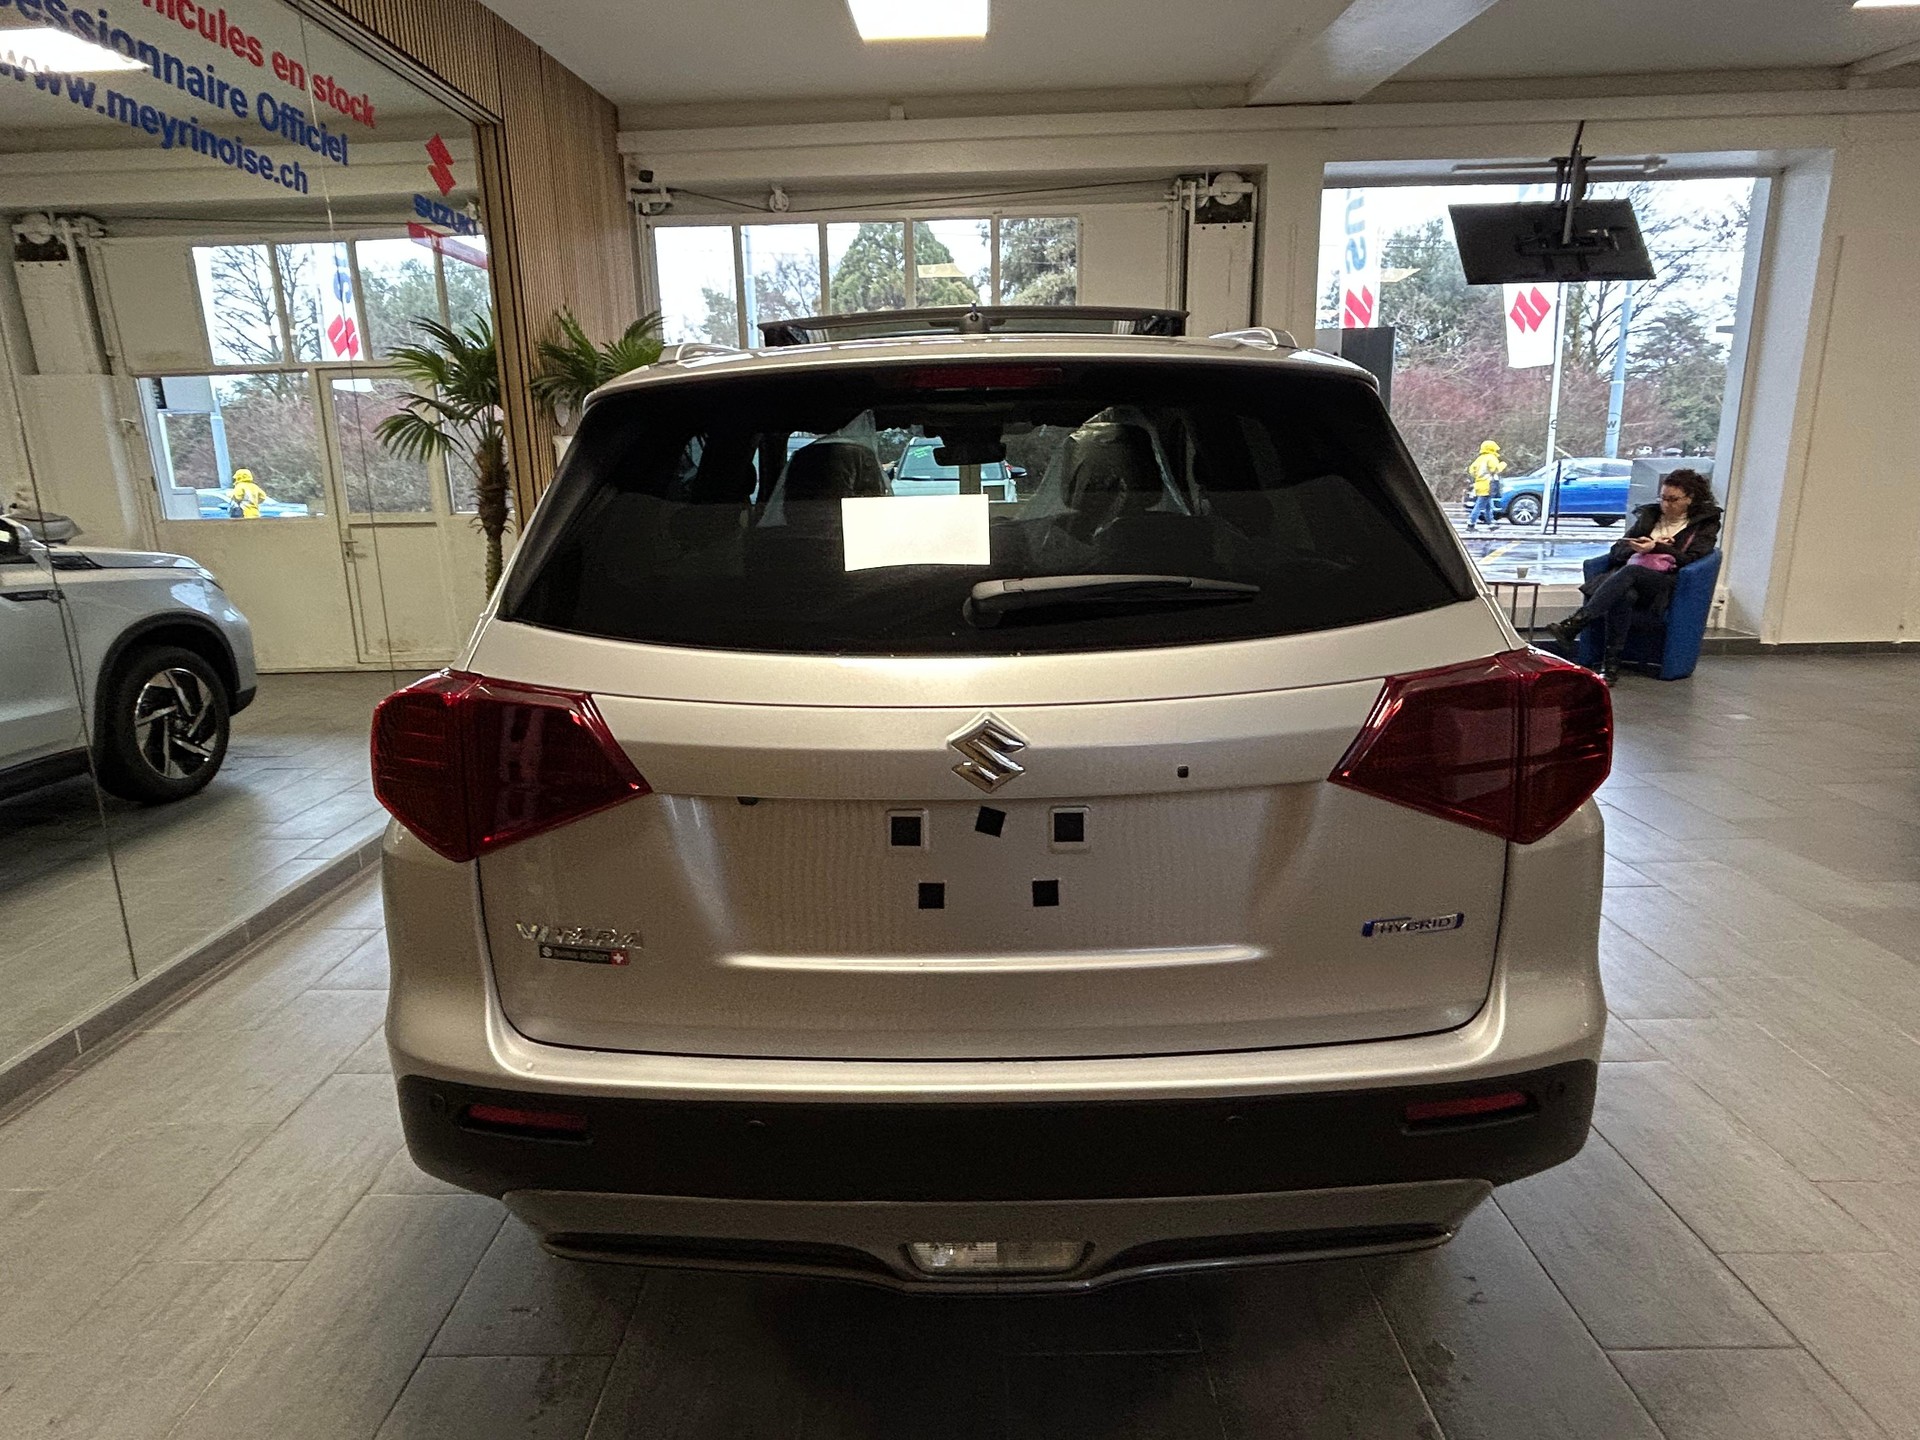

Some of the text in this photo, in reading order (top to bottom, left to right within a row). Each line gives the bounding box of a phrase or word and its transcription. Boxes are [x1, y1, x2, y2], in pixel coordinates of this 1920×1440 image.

[271, 51, 305, 91] en
[313, 73, 375, 129] stock
[257, 92, 349, 166] Officiel
[1380, 918, 1451, 933] HYBRID
